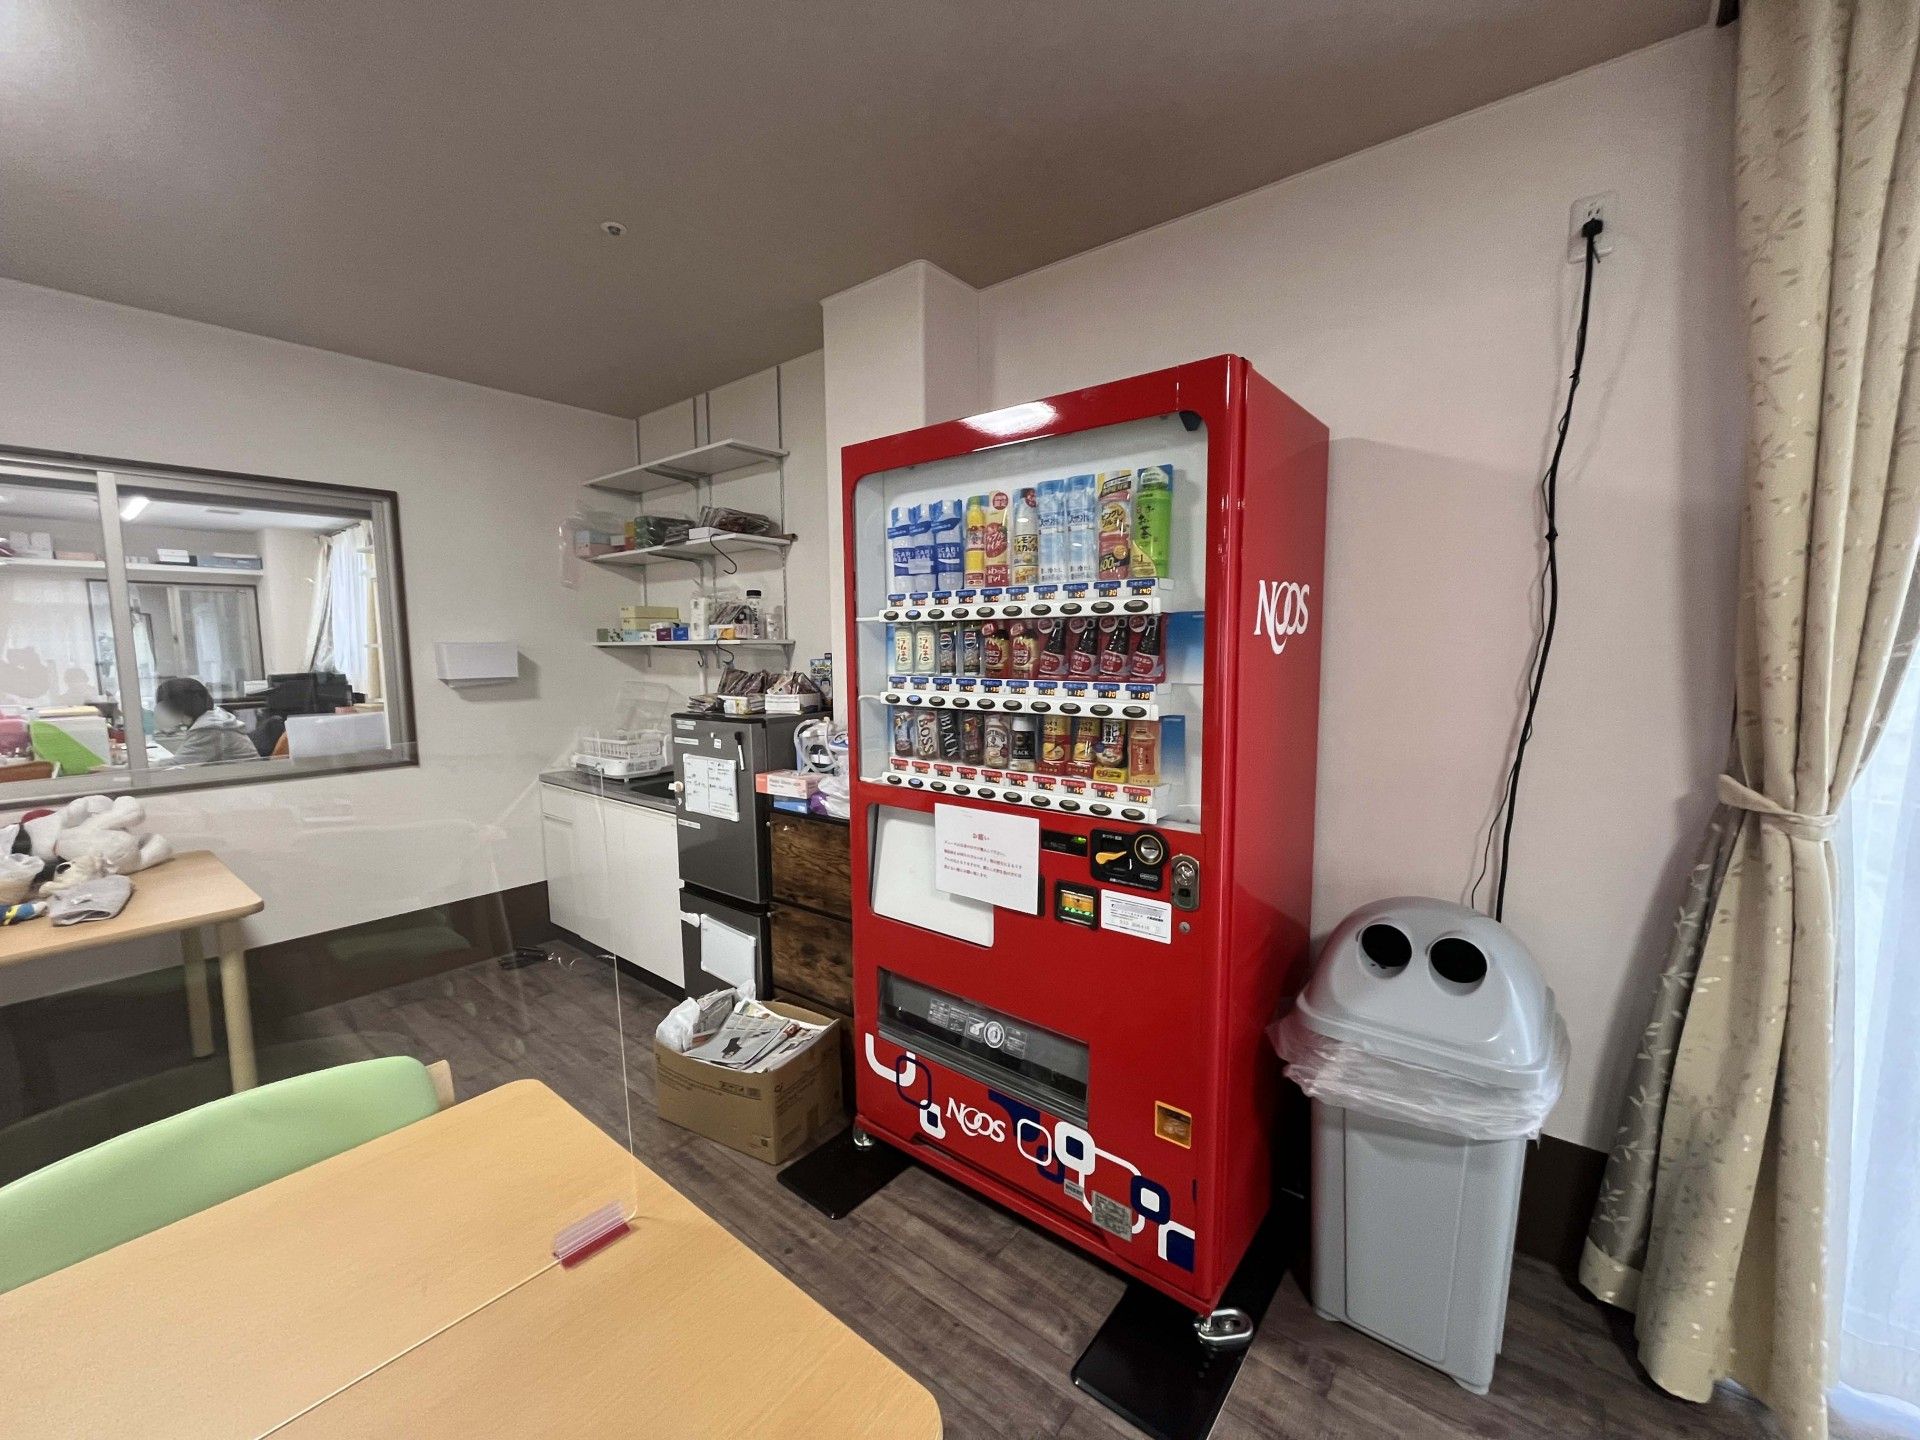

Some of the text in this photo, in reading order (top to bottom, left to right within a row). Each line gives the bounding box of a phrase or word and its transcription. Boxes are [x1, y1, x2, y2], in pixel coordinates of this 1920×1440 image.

[1105, 690, 1117, 698] 130
[1137, 691, 1150, 699] 130
[919, 718, 934, 754] BOSS
[940, 713, 960, 757] BLACK
